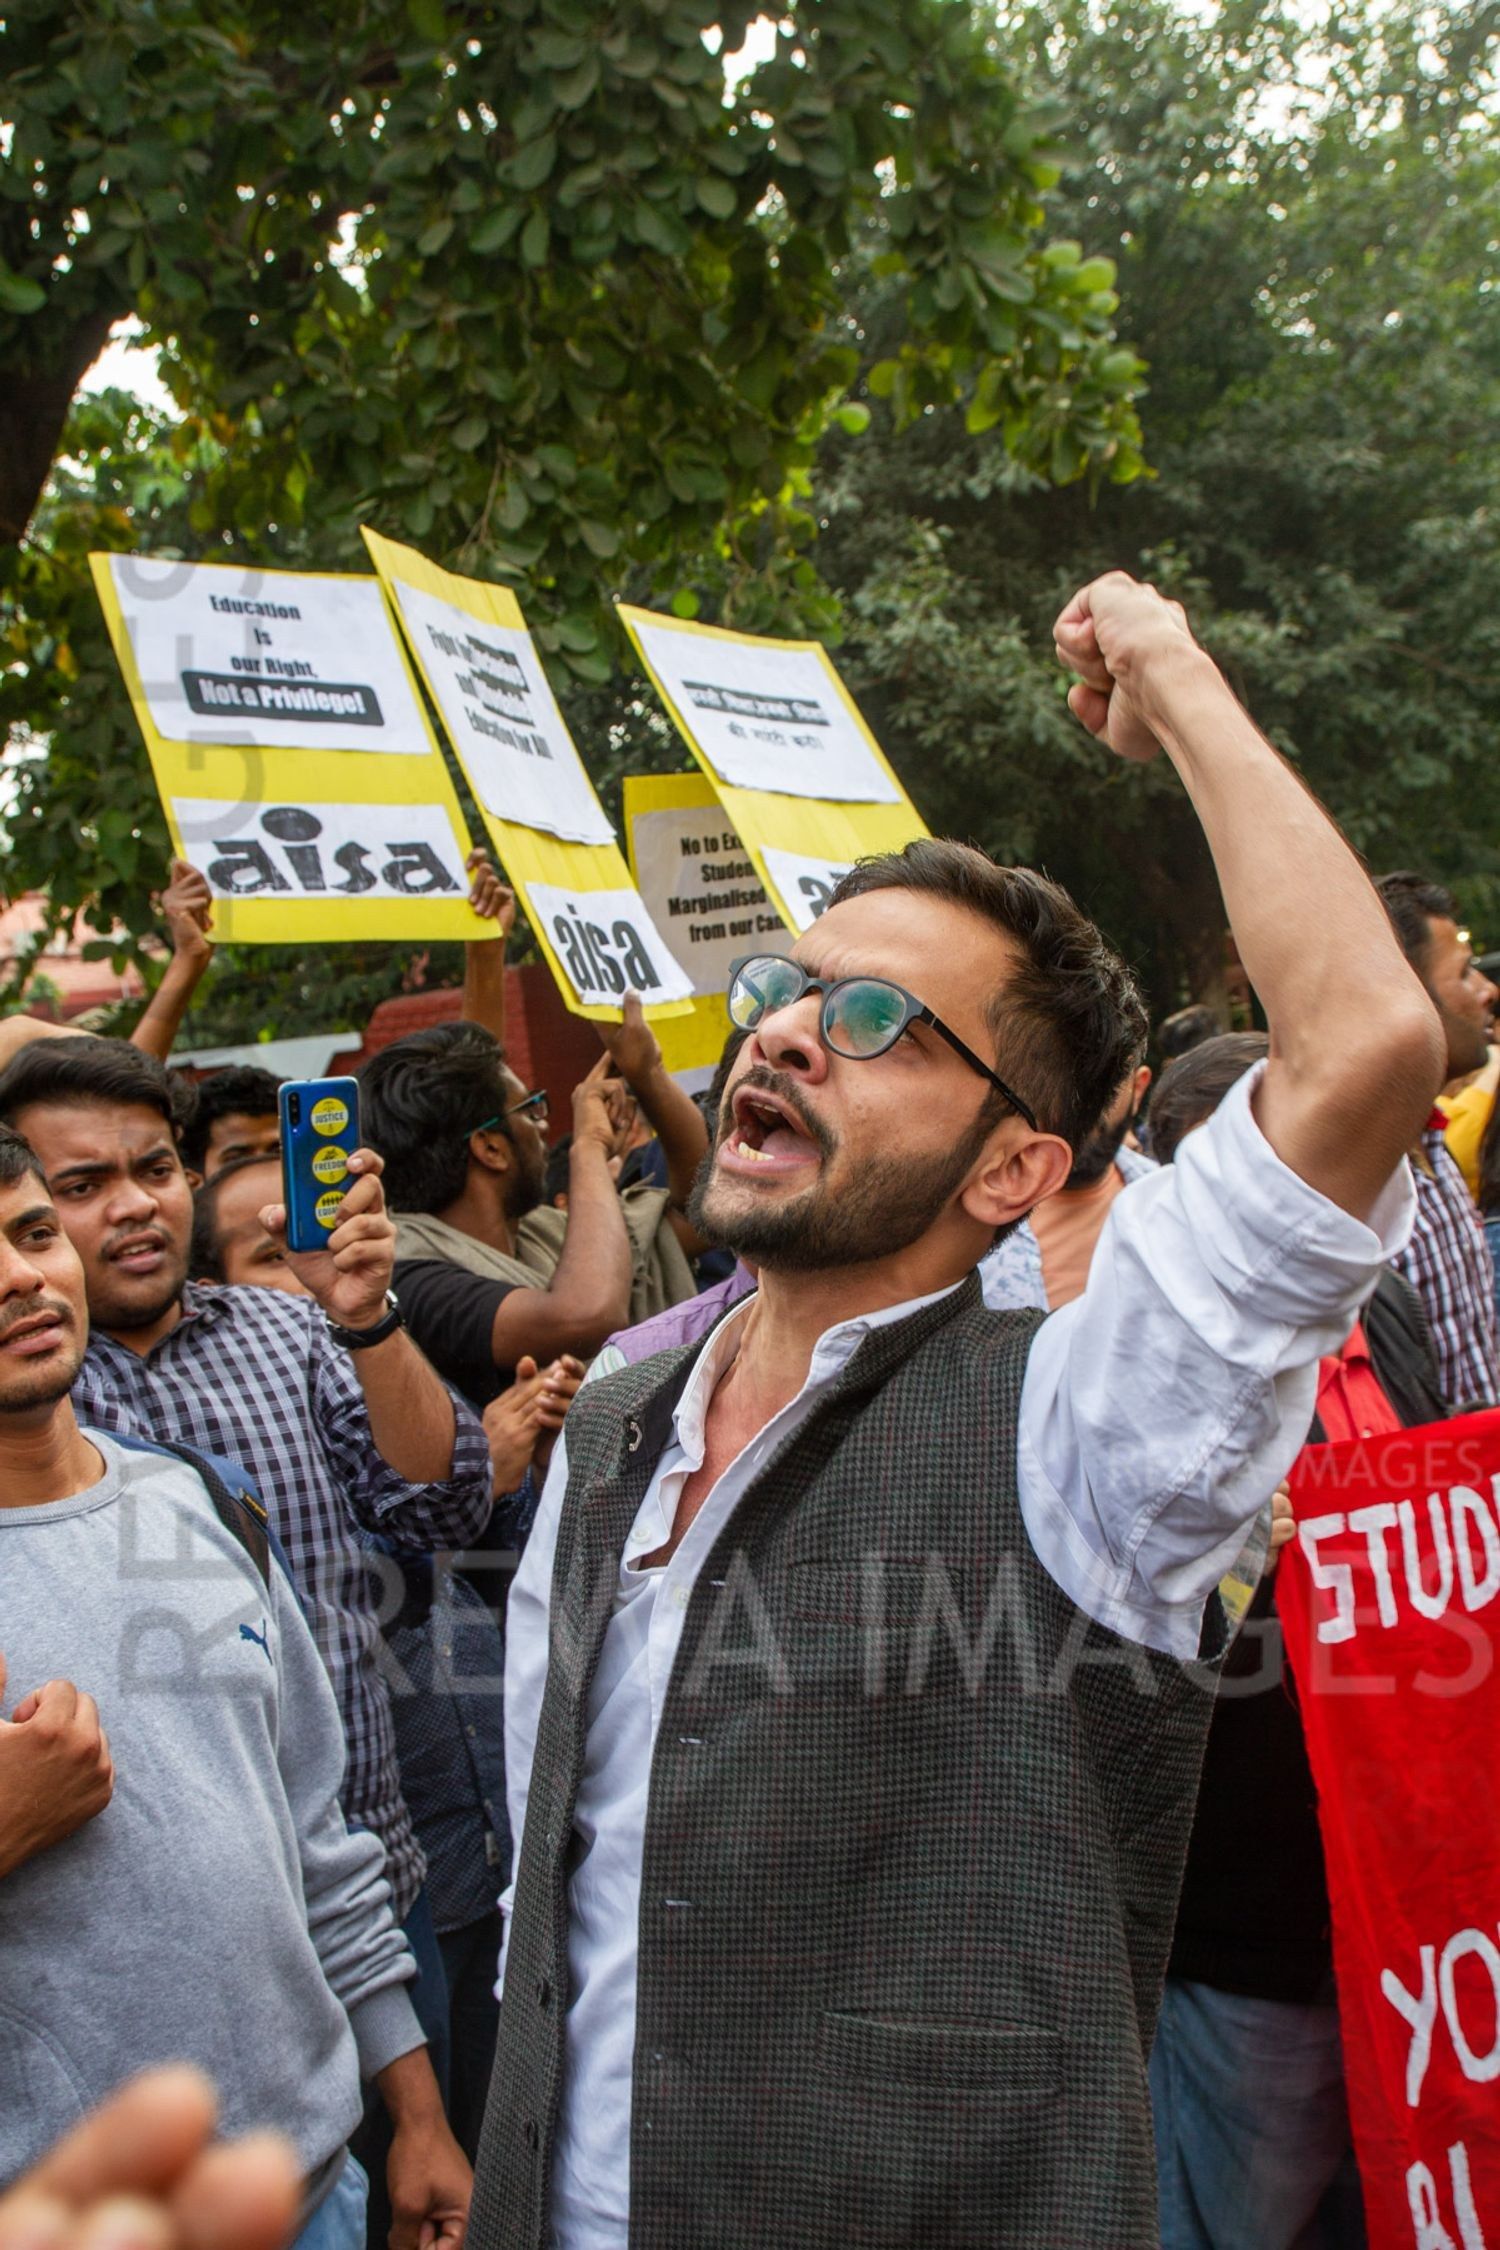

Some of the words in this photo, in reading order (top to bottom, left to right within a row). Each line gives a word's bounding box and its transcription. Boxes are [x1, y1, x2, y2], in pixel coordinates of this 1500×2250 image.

[209, 595, 302, 620] Education
[230, 656, 261, 673] our
[198, 679, 241, 705] Not
[243, 685, 259, 706] a
[257, 684, 367, 715] Privilege!
[207, 807, 462, 894] aisa
[680, 837, 700, 856] No
[703, 835, 719, 853] to
[668, 886, 767, 917] Marginalised
[690, 921, 726, 942] from
[729, 919, 754, 937] our
[553, 902, 662, 995] aisa
[315, 1112, 345, 1123] JUSTICE
[1298, 1473, 1500, 1645] STUD
[1381, 1920, 1500, 2108] YO
